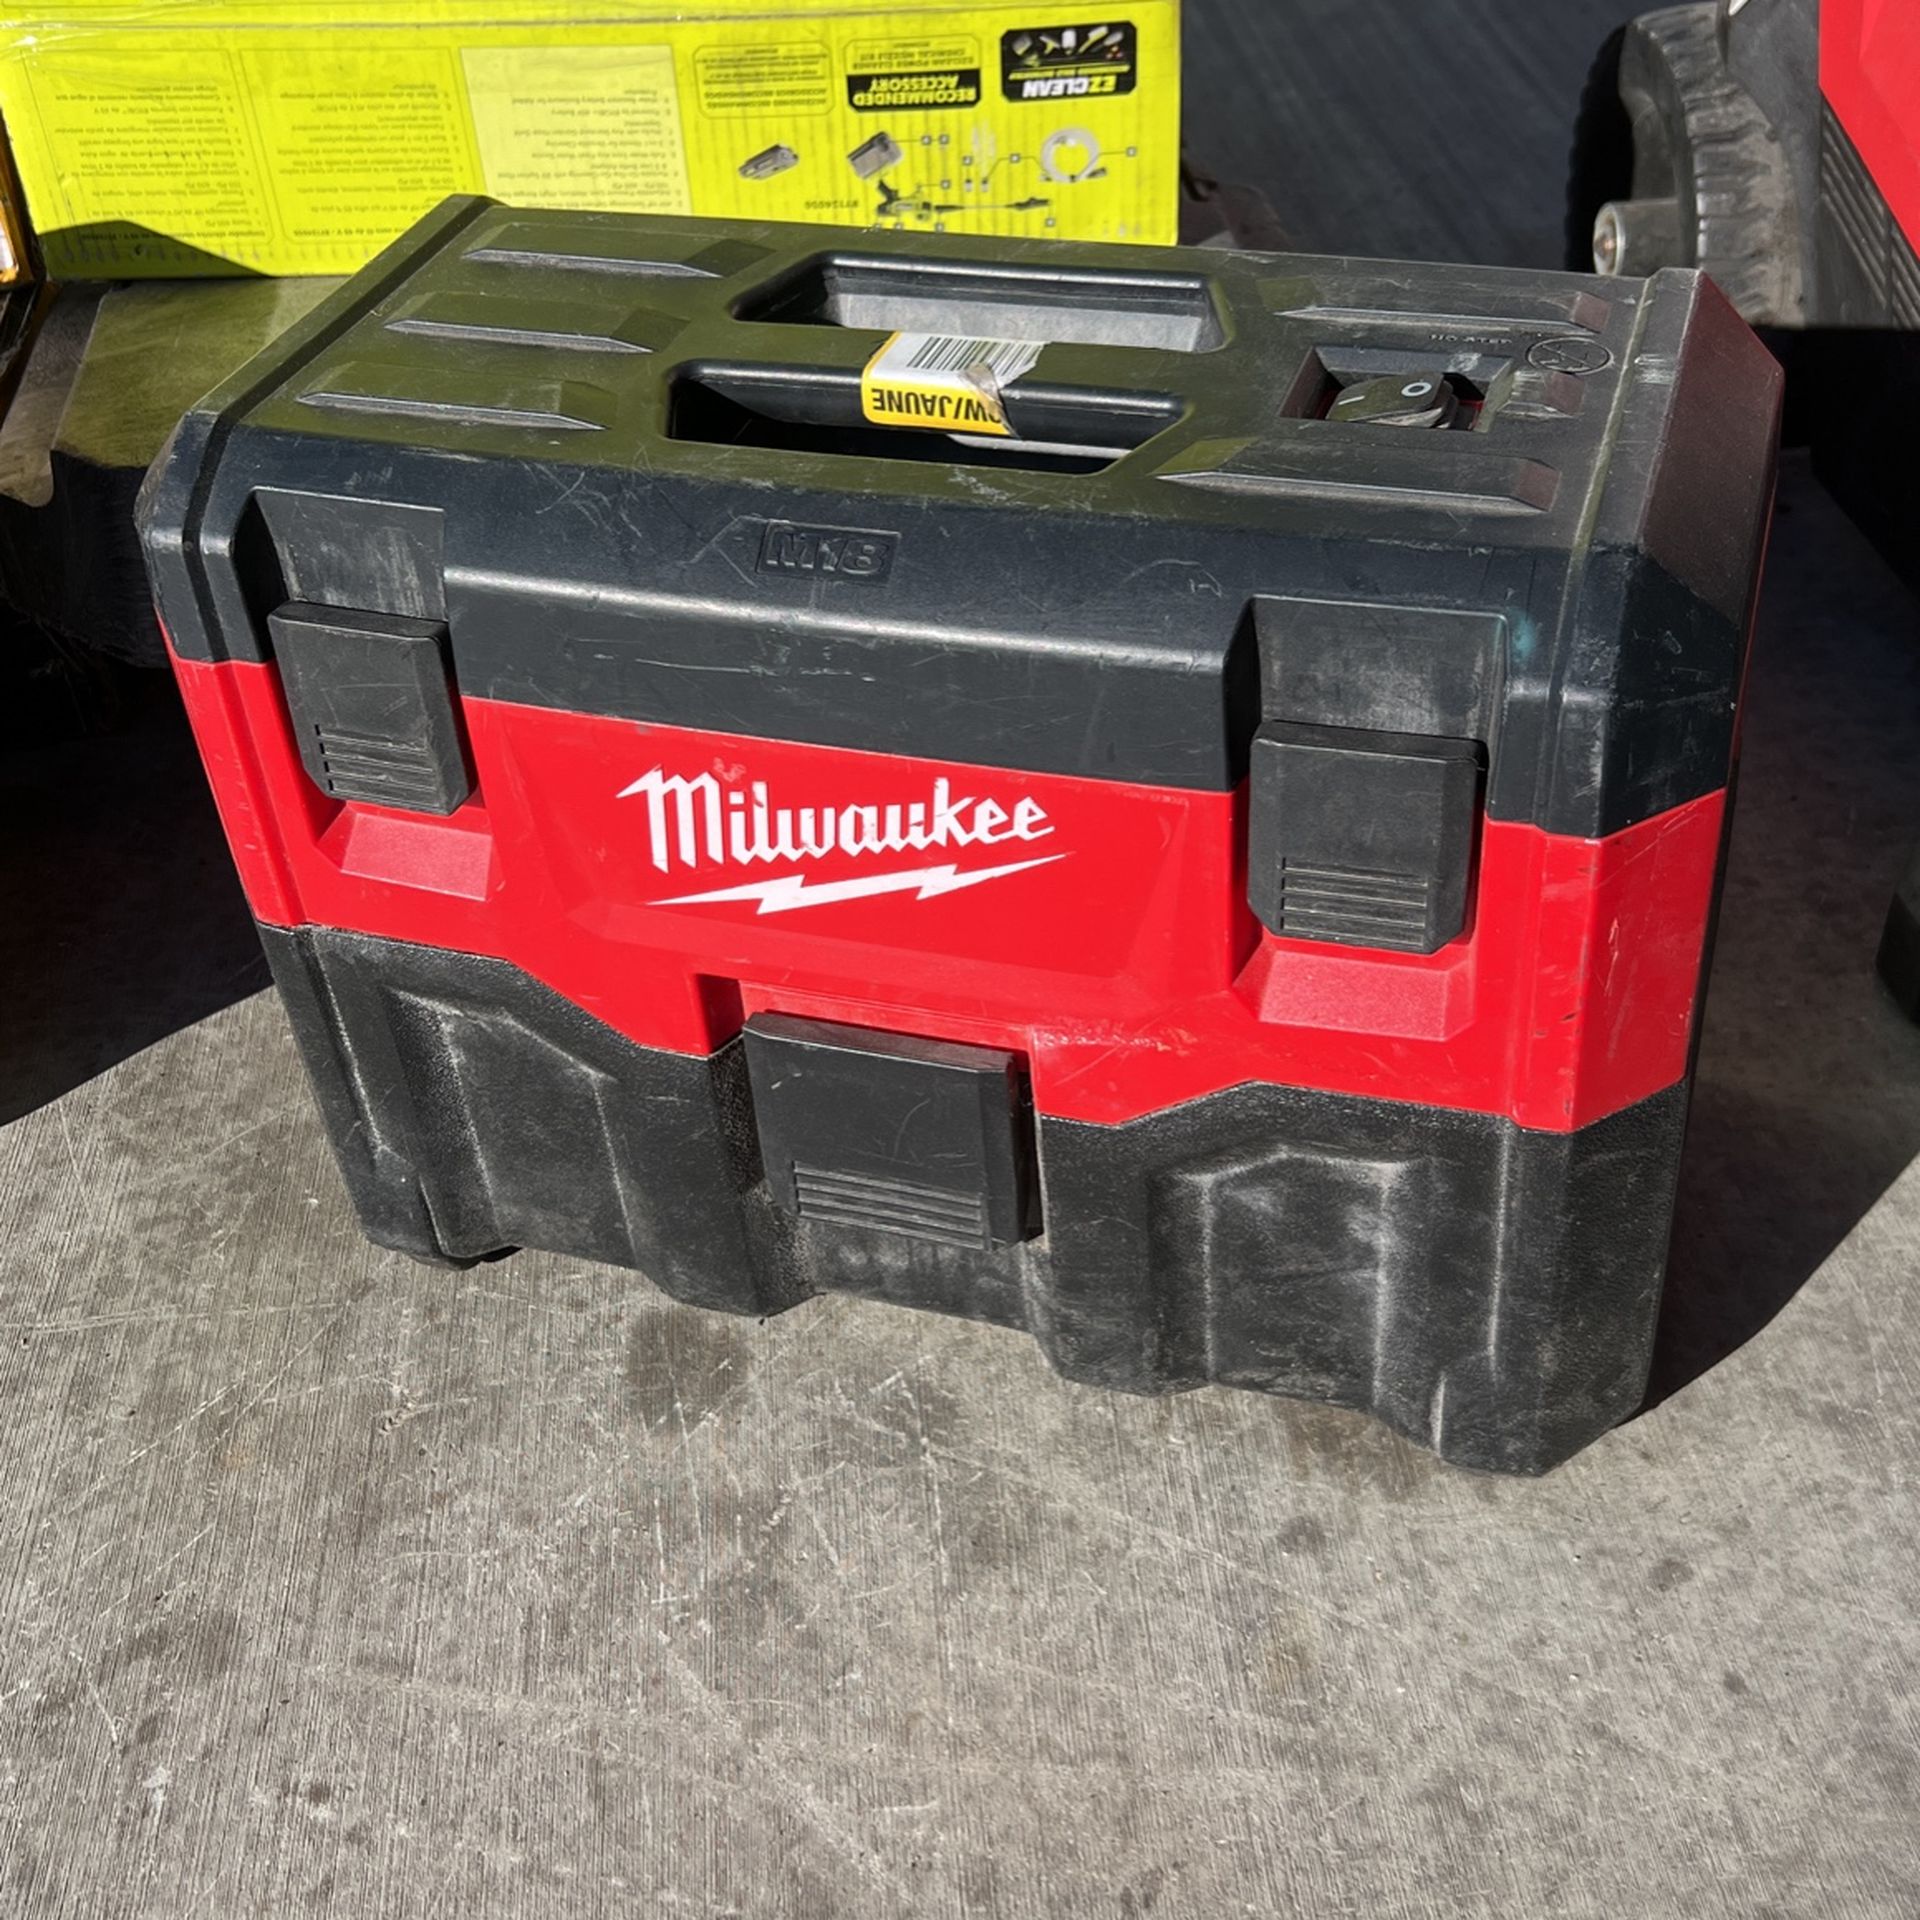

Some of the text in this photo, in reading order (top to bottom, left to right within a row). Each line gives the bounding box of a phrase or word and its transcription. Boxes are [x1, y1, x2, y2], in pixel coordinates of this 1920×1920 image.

[870, 75, 960, 92] ACCESSORY
[853, 88, 977, 105] RECOMMENDED
[616, 764, 1056, 874] Milwaukee
